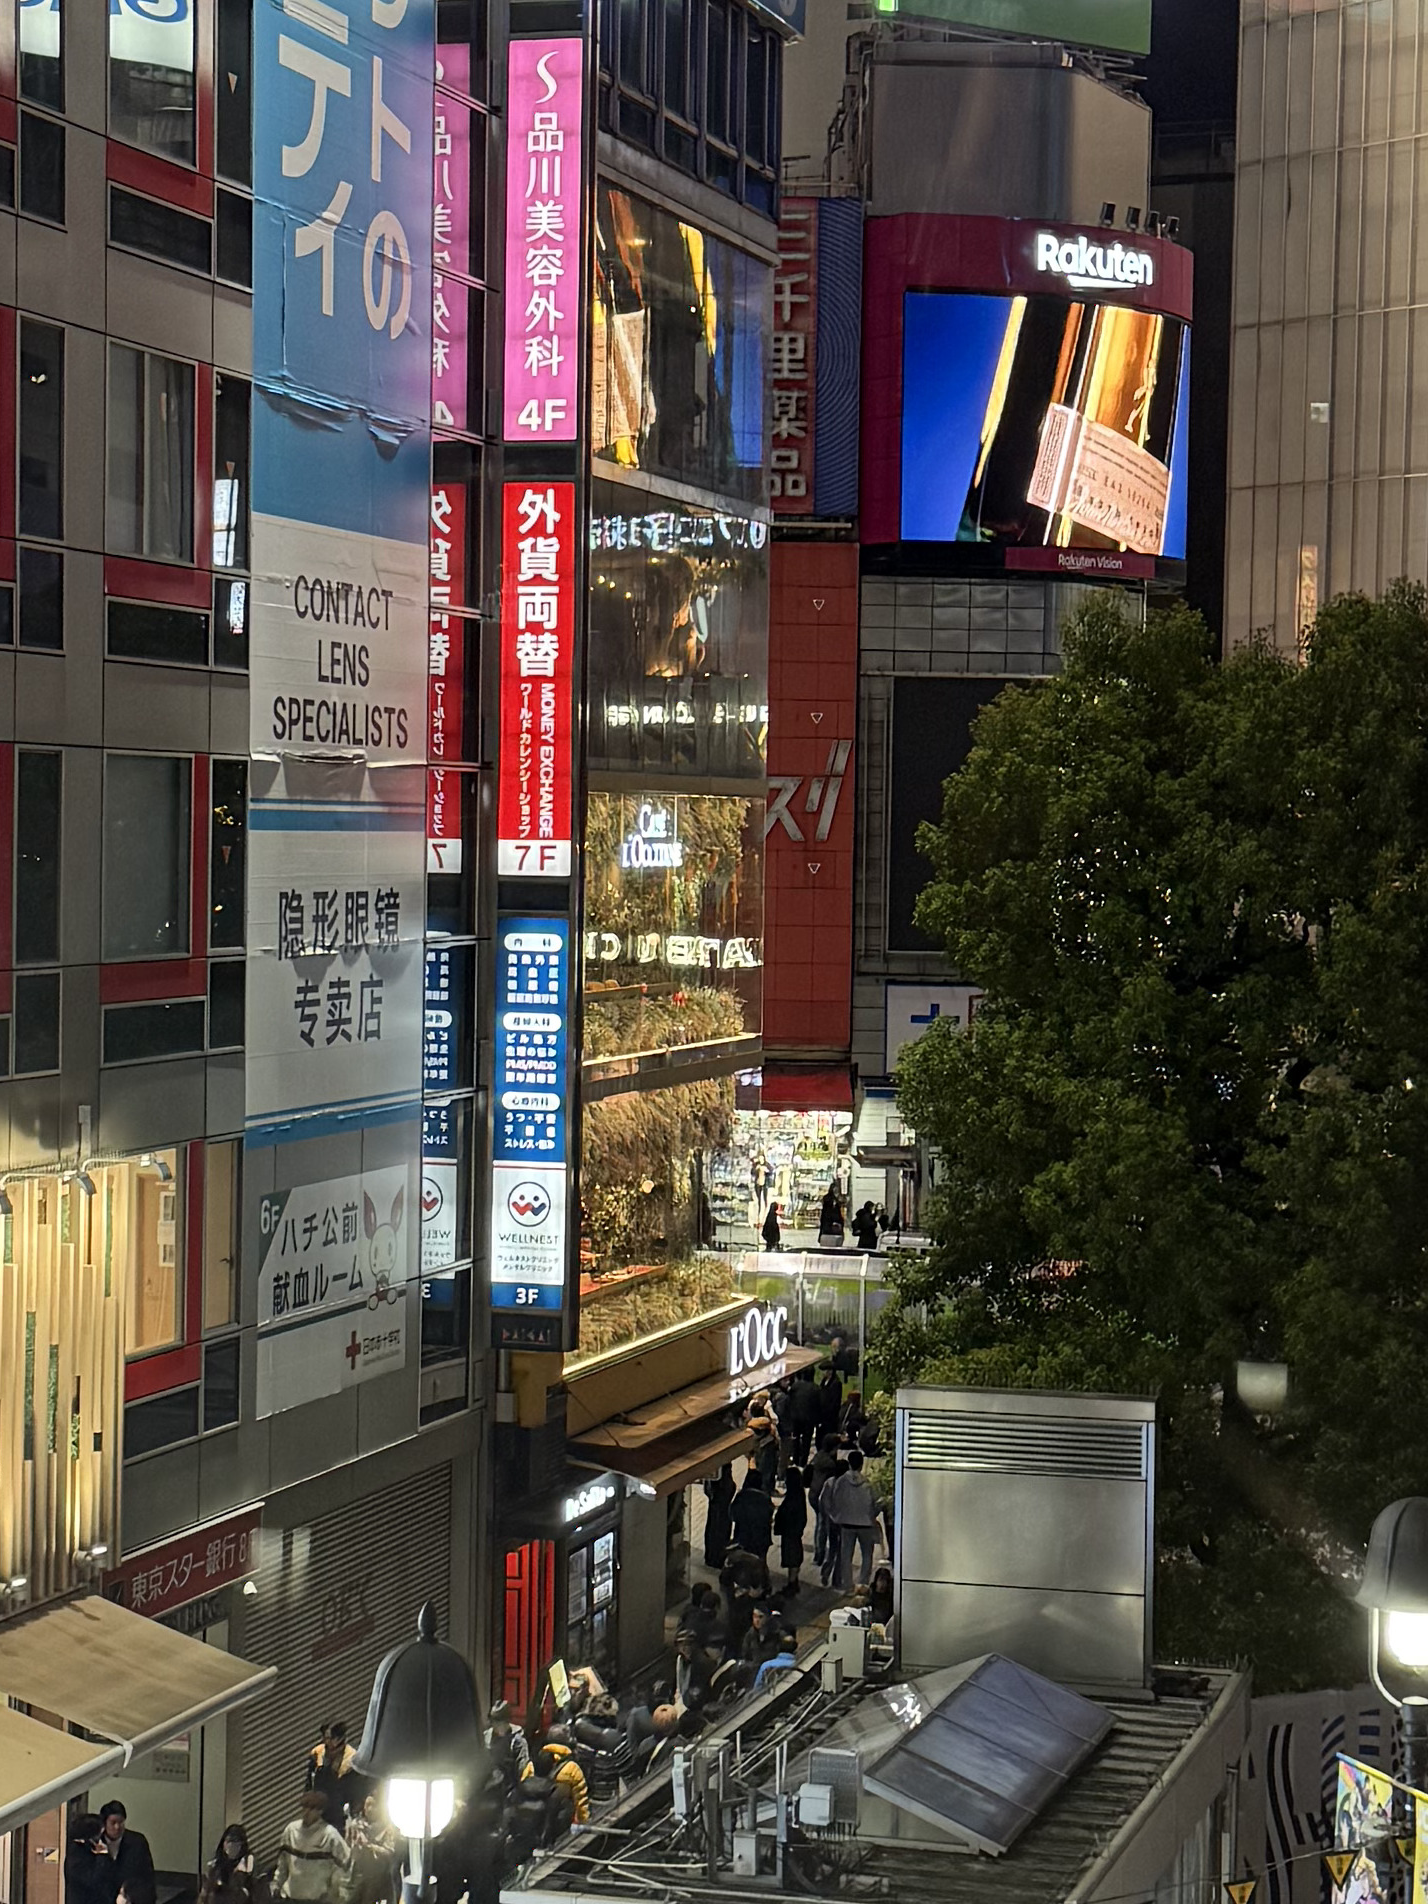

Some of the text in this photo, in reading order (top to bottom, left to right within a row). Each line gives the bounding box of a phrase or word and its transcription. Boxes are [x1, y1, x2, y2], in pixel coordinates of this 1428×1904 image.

[525, 110, 564, 378] 品川美容外科
[1037, 233, 1152, 286] Rakuten
[517, 398, 567, 433] 4F
[293, 573, 394, 631] CONTACT
[516, 487, 562, 678] 外貨両替
[317, 640, 370, 689] LENS
[272, 697, 409, 751] SPECIALISTS
[539, 682, 555, 839] MONEY EXCHANGE
[514, 844, 558, 871] 7F
[278, 887, 401, 963] 隐形眼镜
[293, 974, 384, 1049] 专卖店
[280, 1200, 359, 1256] ハチ公前
[272, 1254, 364, 1317] 献血ルーム
[515, 1287, 539, 1305] 3F
